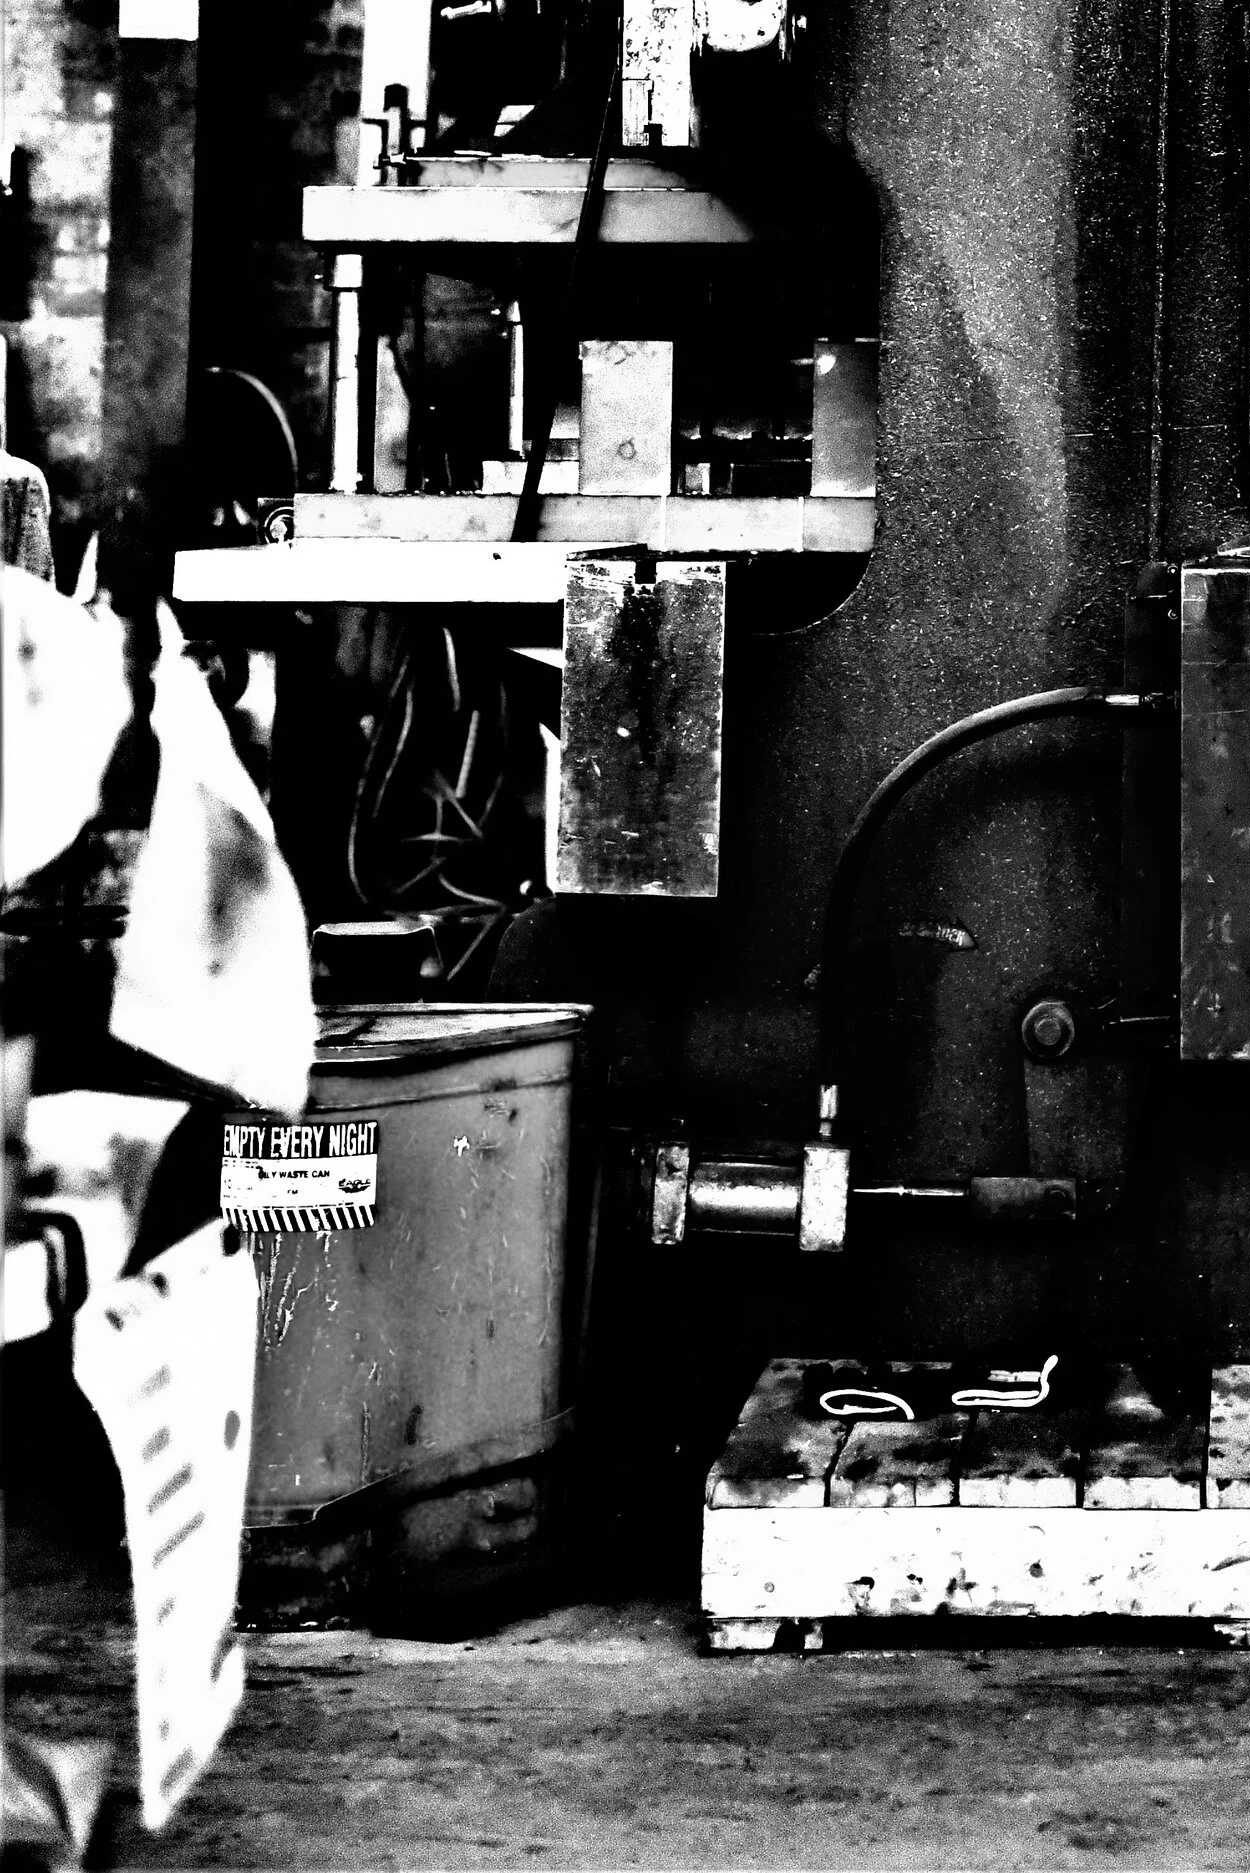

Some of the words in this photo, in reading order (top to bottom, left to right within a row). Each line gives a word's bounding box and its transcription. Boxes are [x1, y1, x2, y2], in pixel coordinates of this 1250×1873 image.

[223, 1124, 267, 1158] EMPTY
[271, 1125, 324, 1158] EVERY
[328, 1122, 378, 1156] NIGHT
[279, 1170, 309, 1179] WASTE
[311, 1170, 330, 1178] CAN
